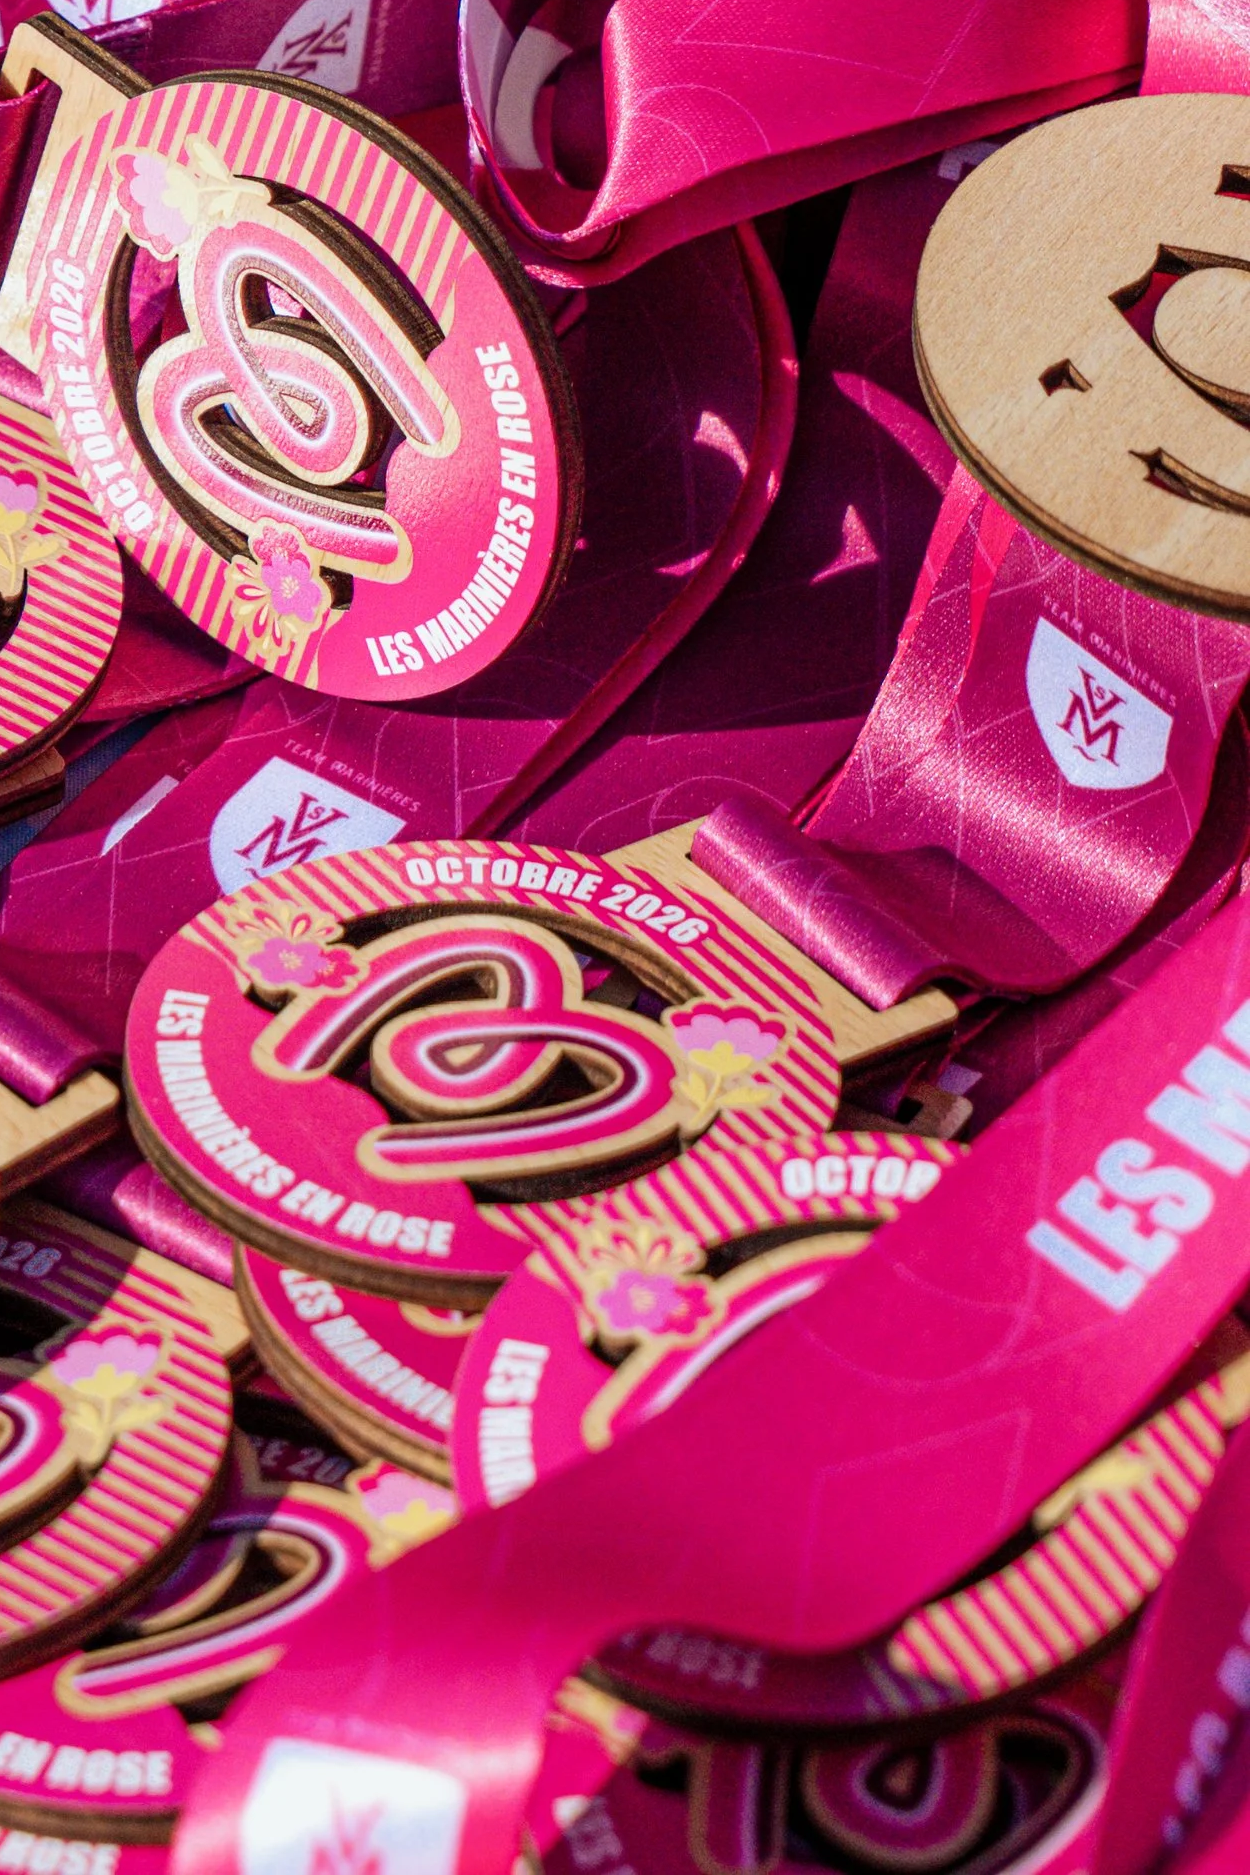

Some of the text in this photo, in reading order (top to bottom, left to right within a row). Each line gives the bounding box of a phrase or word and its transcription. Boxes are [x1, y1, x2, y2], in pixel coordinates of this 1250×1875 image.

[46, 260, 154, 533] OCTOBRE 2026
[365, 340, 537, 677] LES MARINIÈRES EN ROSE
[284, 738, 327, 766] TEAM
[406, 855, 708, 946] OCTOBRE 2026
[154, 988, 456, 1257] LES MARINIÈRES EN ROSE
[1025, 1137, 1216, 1315] LES
[484, 1338, 549, 1405] LES
[46, 1744, 174, 1796] ROSE
